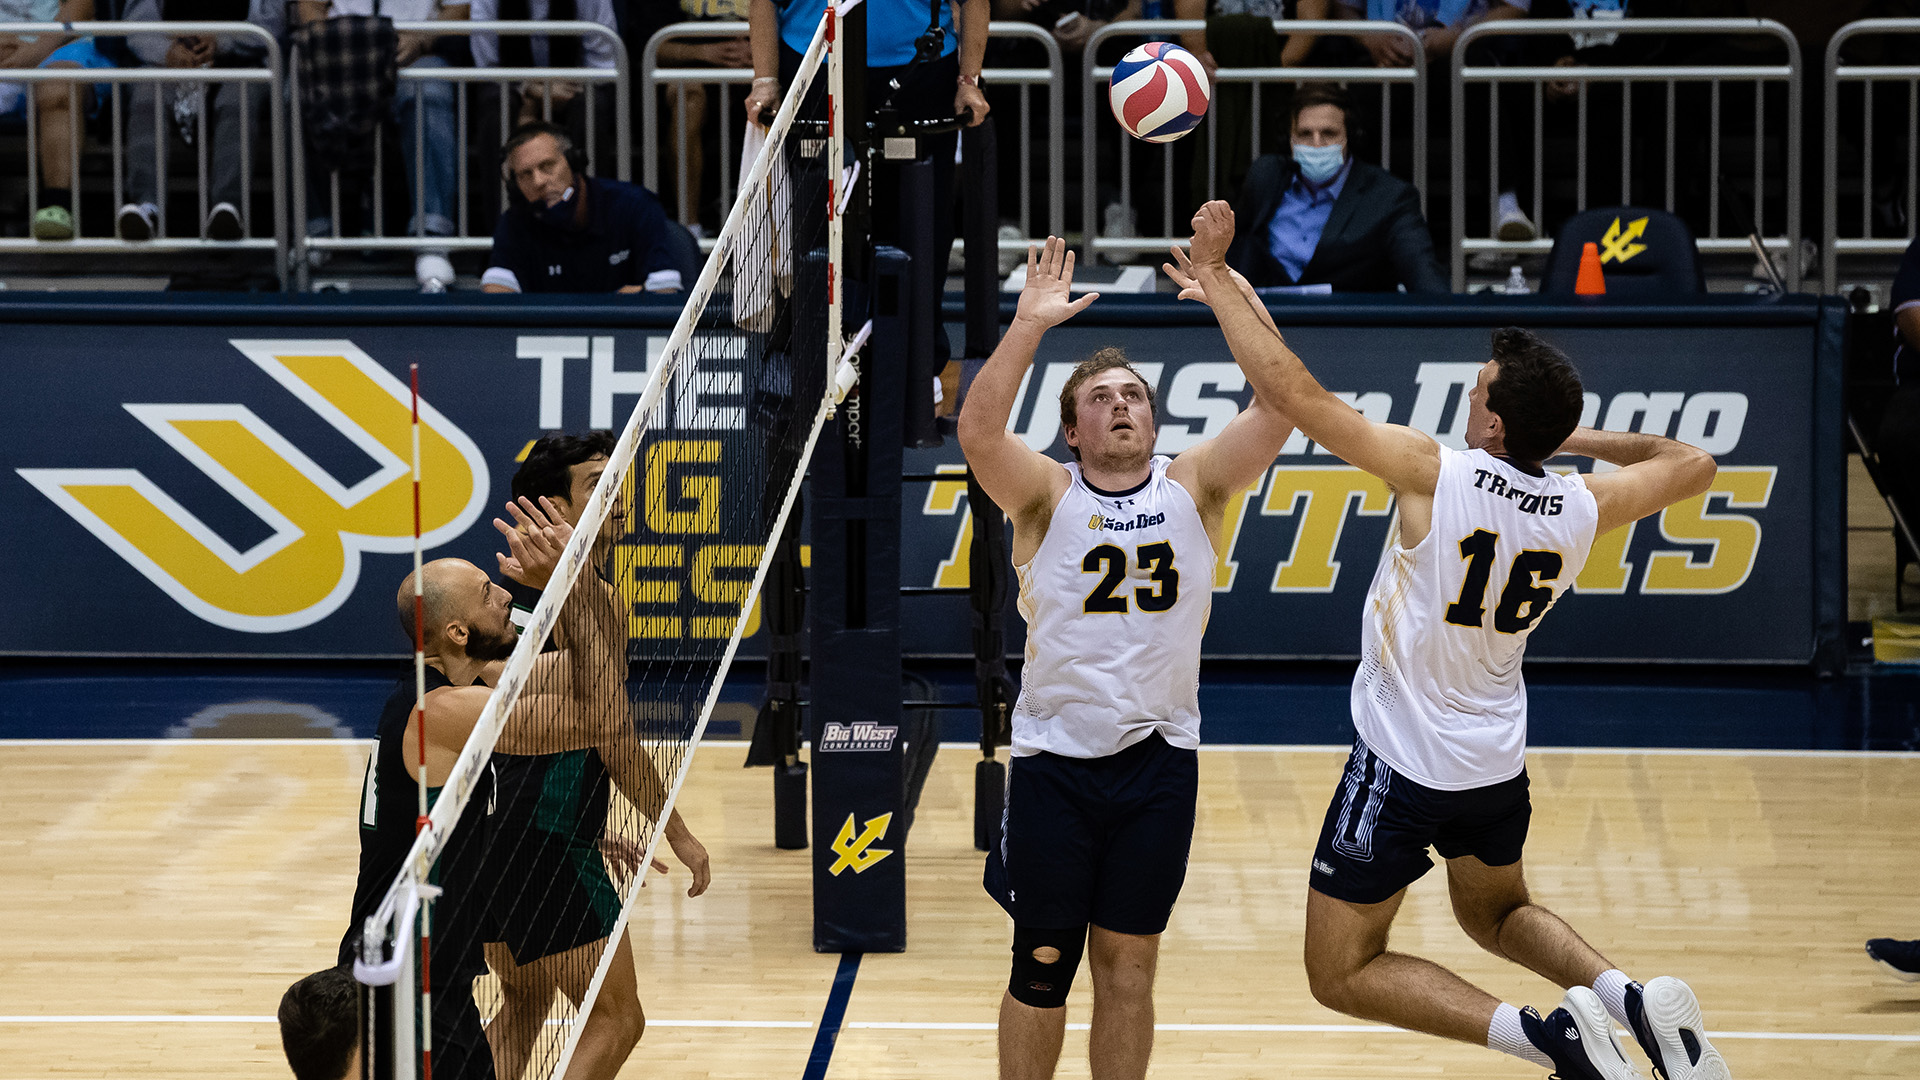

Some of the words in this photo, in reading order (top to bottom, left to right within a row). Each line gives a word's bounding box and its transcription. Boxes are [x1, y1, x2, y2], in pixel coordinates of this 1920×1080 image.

[516, 336, 747, 429] THE
[1081, 539, 1180, 615] 23
[1443, 527, 1564, 635] 16
[853, 725, 895, 741] WEST
